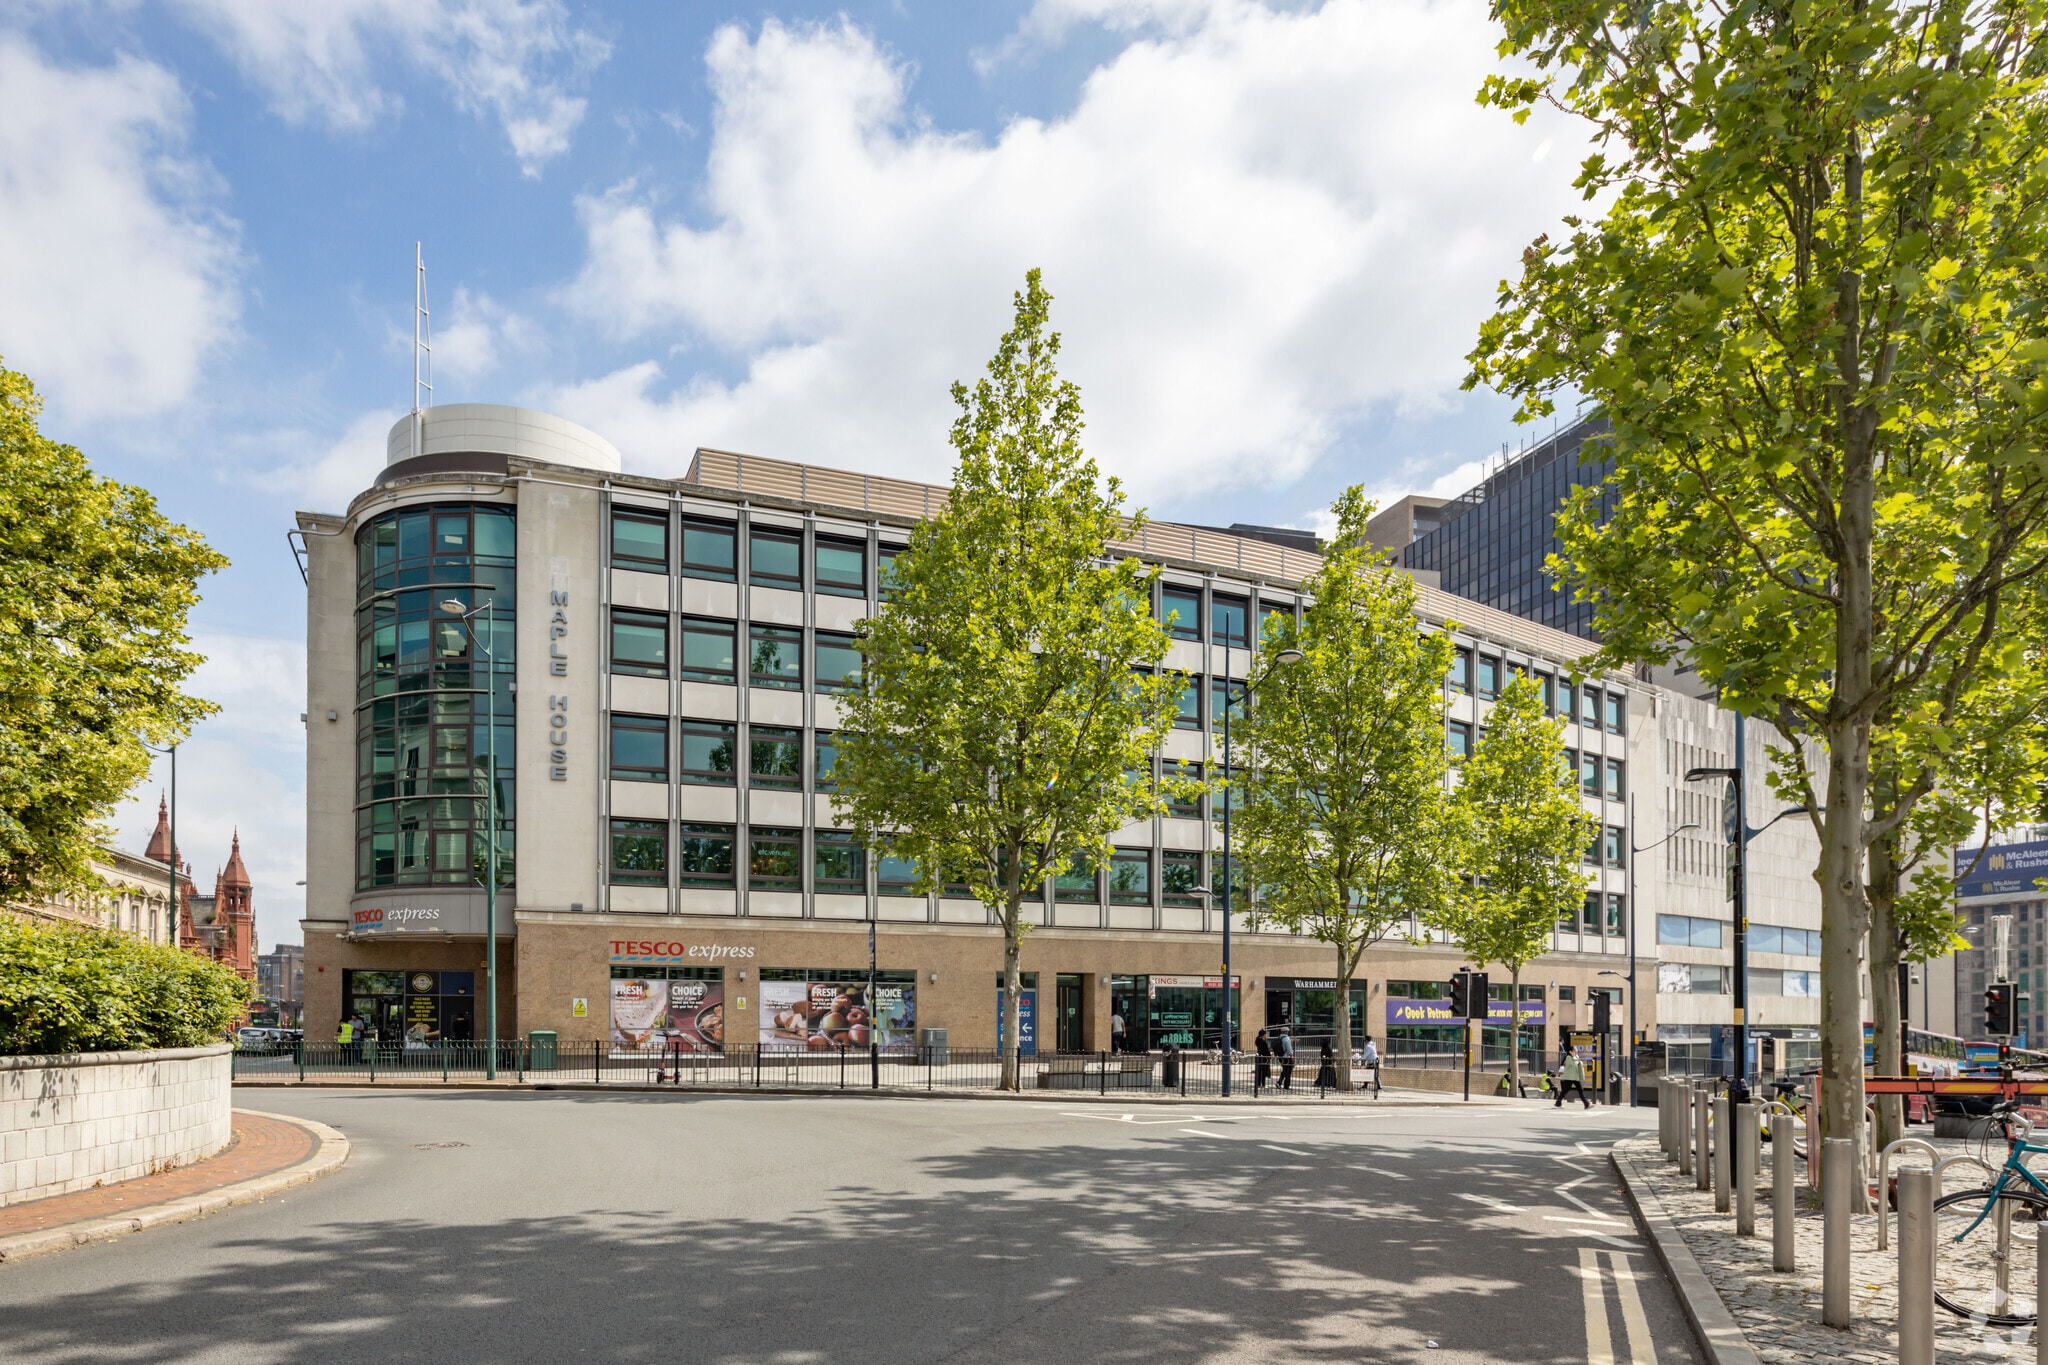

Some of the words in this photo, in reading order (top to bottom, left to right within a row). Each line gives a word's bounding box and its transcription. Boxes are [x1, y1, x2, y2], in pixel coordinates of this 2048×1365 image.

[550, 590, 569, 677] MAPLE
[549, 695, 568, 782] HOUSE
[2006, 850, 2048, 861] McAleer
[2006, 861, 2014, 869] &
[354, 909, 383, 924] TESCO
[388, 908, 440, 924] express
[609, 941, 685, 956] TESCO
[688, 944, 755, 962] express
[1152, 977, 1178, 985] KINGS
[615, 985, 643, 995] FRESH
[672, 986, 703, 996] CHOICE
[811, 988, 837, 997] FRESH
[875, 988, 903, 998] CHOICE
[1405, 1006, 1425, 1019] Geek
